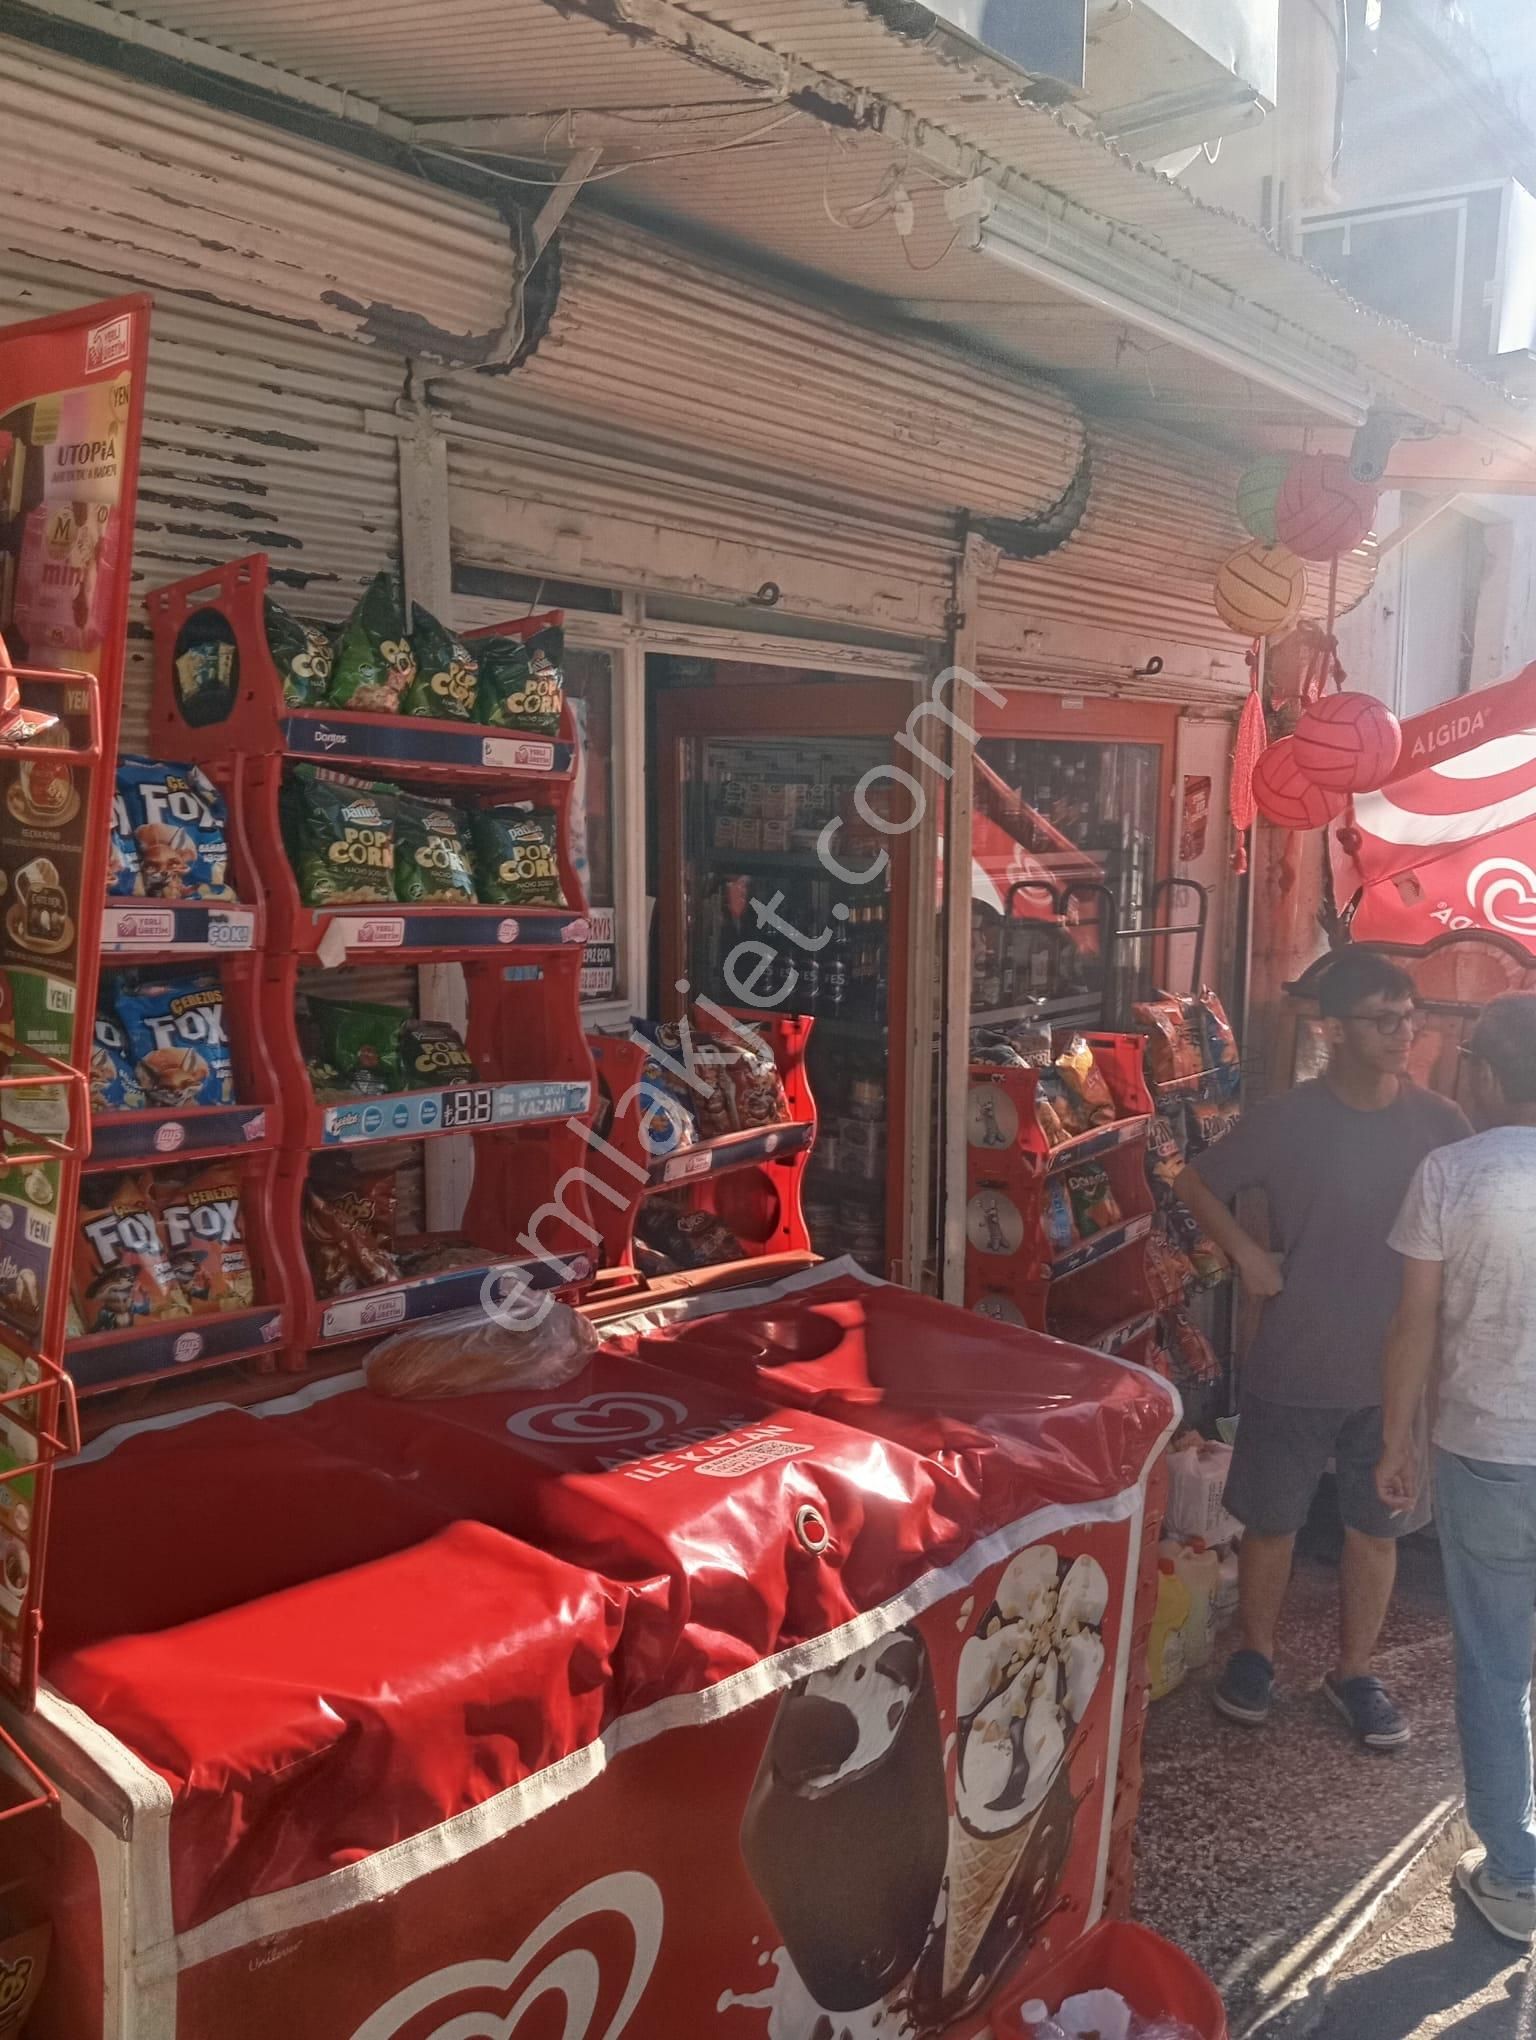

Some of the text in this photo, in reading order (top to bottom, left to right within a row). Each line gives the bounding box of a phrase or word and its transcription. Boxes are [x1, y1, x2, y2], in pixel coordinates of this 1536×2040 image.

[525, 679, 558, 697] POP
[507, 692, 562, 714] CORN
[314, 731, 347, 743] Doritos
[344, 827, 387, 847] POP
[329, 841, 394, 869] CORN
[512, 844, 552, 861] POP
[138, 917, 162, 926] YERLİ
[138, 926, 169, 934] ÜRETİM
[143, 1004, 228, 1050] FOX
[163, 1200, 241, 1246] FOX
[85, 1211, 162, 1266] FOX
[676, 1424, 794, 1463] KAZAN
